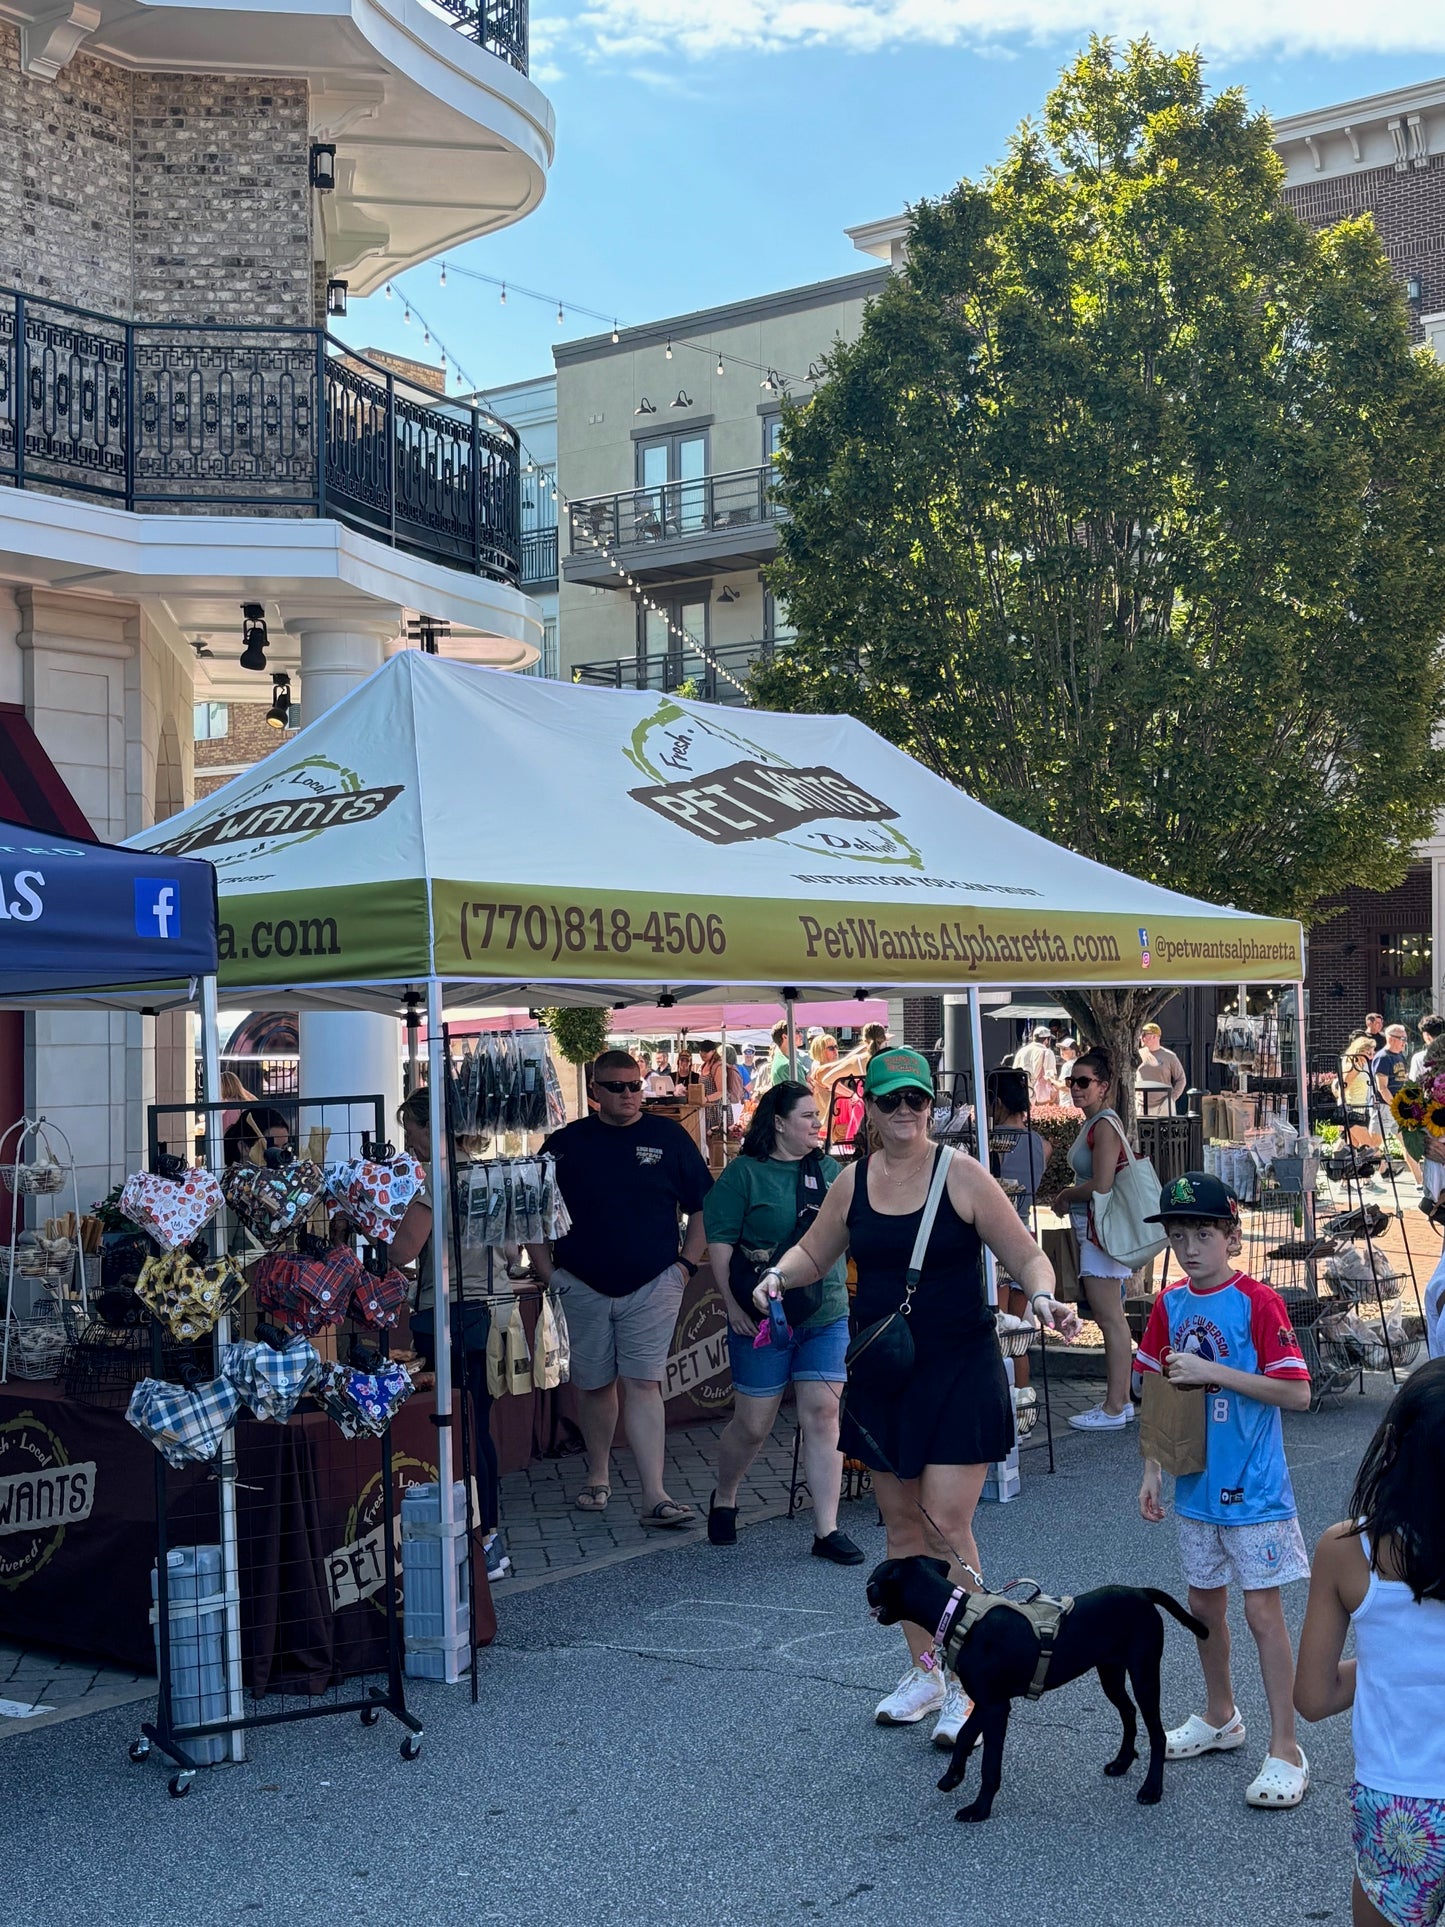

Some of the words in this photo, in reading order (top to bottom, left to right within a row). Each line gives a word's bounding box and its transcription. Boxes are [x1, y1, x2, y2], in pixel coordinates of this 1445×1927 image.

[659, 731, 694, 771] Fresh
[289, 771, 336, 794] Local
[651, 784, 775, 836] PET
[733, 769, 881, 814] WANTS
[214, 794, 384, 841] WANTS
[0, 870, 46, 922] S
[789, 874, 918, 887] NUTRITION
[909, 876, 955, 888] YOU
[460, 901, 726, 961] (770)818-4506
[799, 915, 1121, 971] PetWantsAlpharetta.com
[1155, 935, 1296, 964] @petwantsalpharetta
[665, 1350, 699, 1393] PET
[1213, 1398, 1229, 1423] 8
[20, 1432, 52, 1467] Local
[363, 1484, 384, 1526] Fres
[329, 1538, 382, 1600] PET
